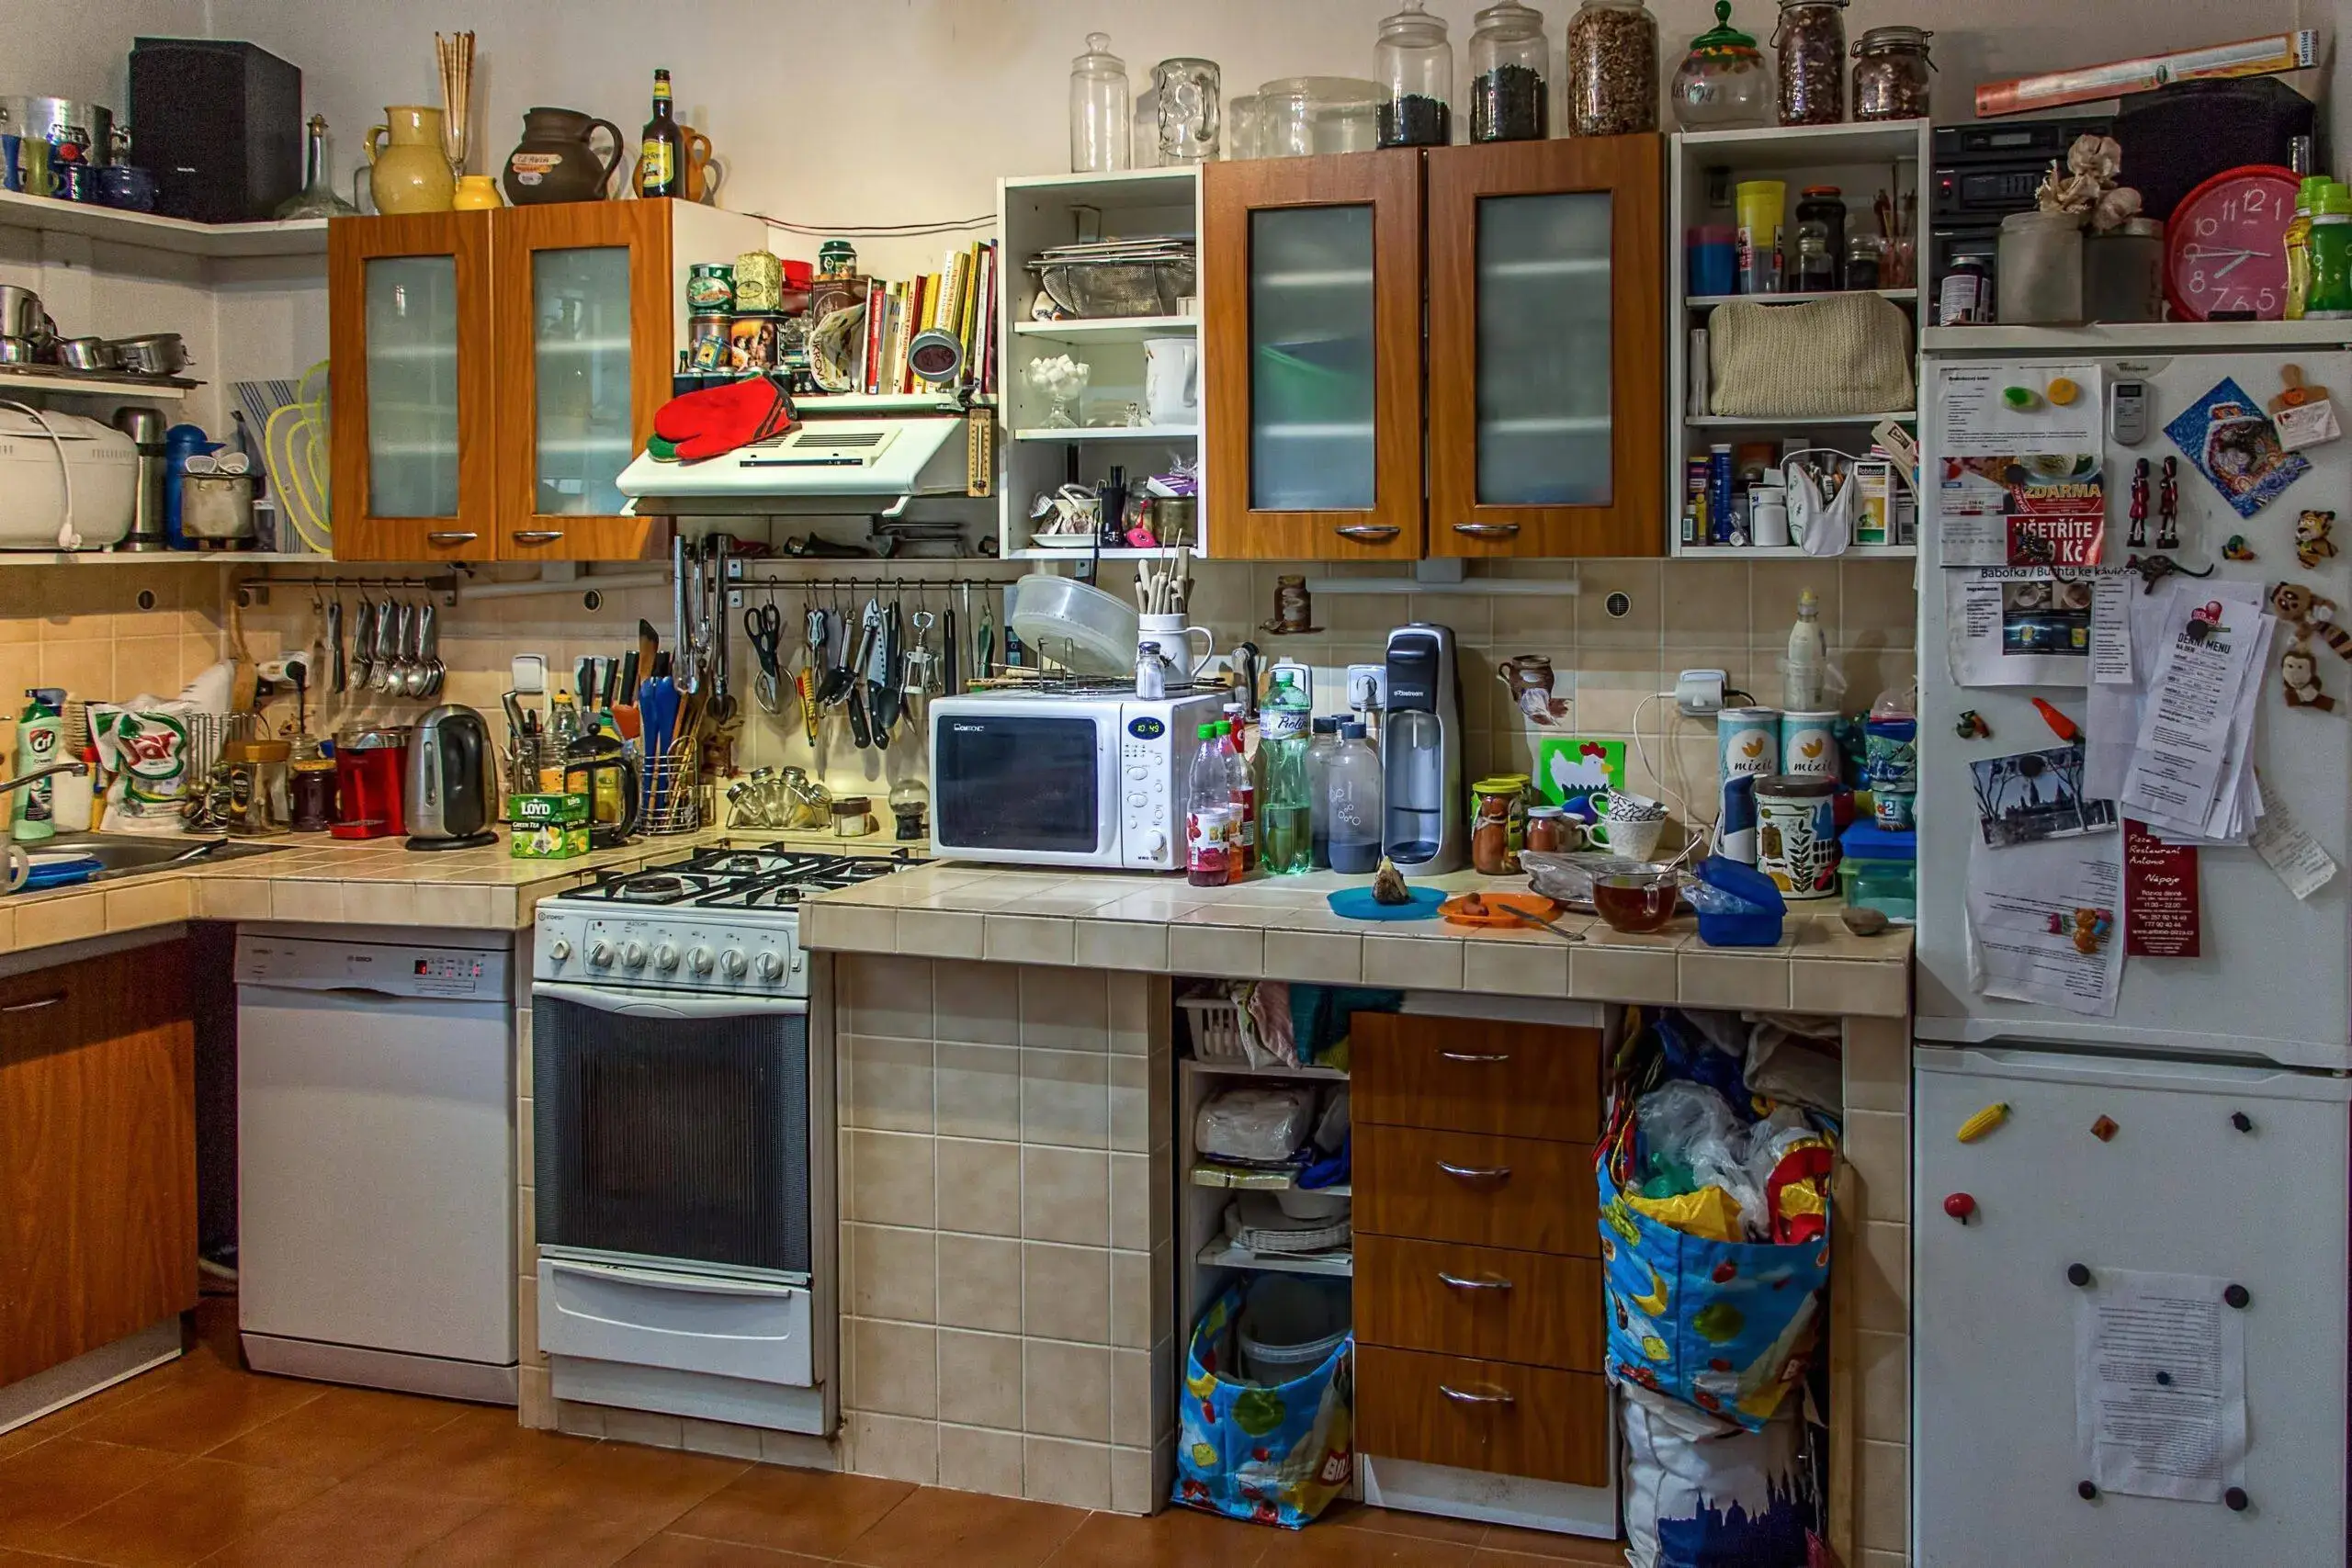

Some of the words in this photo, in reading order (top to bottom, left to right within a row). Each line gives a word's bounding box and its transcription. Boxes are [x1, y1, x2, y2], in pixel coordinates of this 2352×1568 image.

[2222, 200, 2236, 221] 11
[2243, 189, 2266, 212] 12
[2275, 197, 2281, 220] 1
[2195, 217, 2218, 236] 10
[2189, 270, 2205, 293] 8
[2211, 288, 2229, 310] 7
[2256, 288, 2275, 311] 5
[2024, 484, 2102, 499] ZDARMA
[2063, 539, 2083, 562] Kč
[2037, 566, 2075, 577] Buhta
[2078, 566, 2091, 577] ke
[2206, 639, 2231, 654] MENU
[120, 732, 177, 766] Jar
[521, 802, 551, 815] LOYD
[1885, 801, 1894, 815] 2
[2144, 874, 2180, 886] Nápoje
